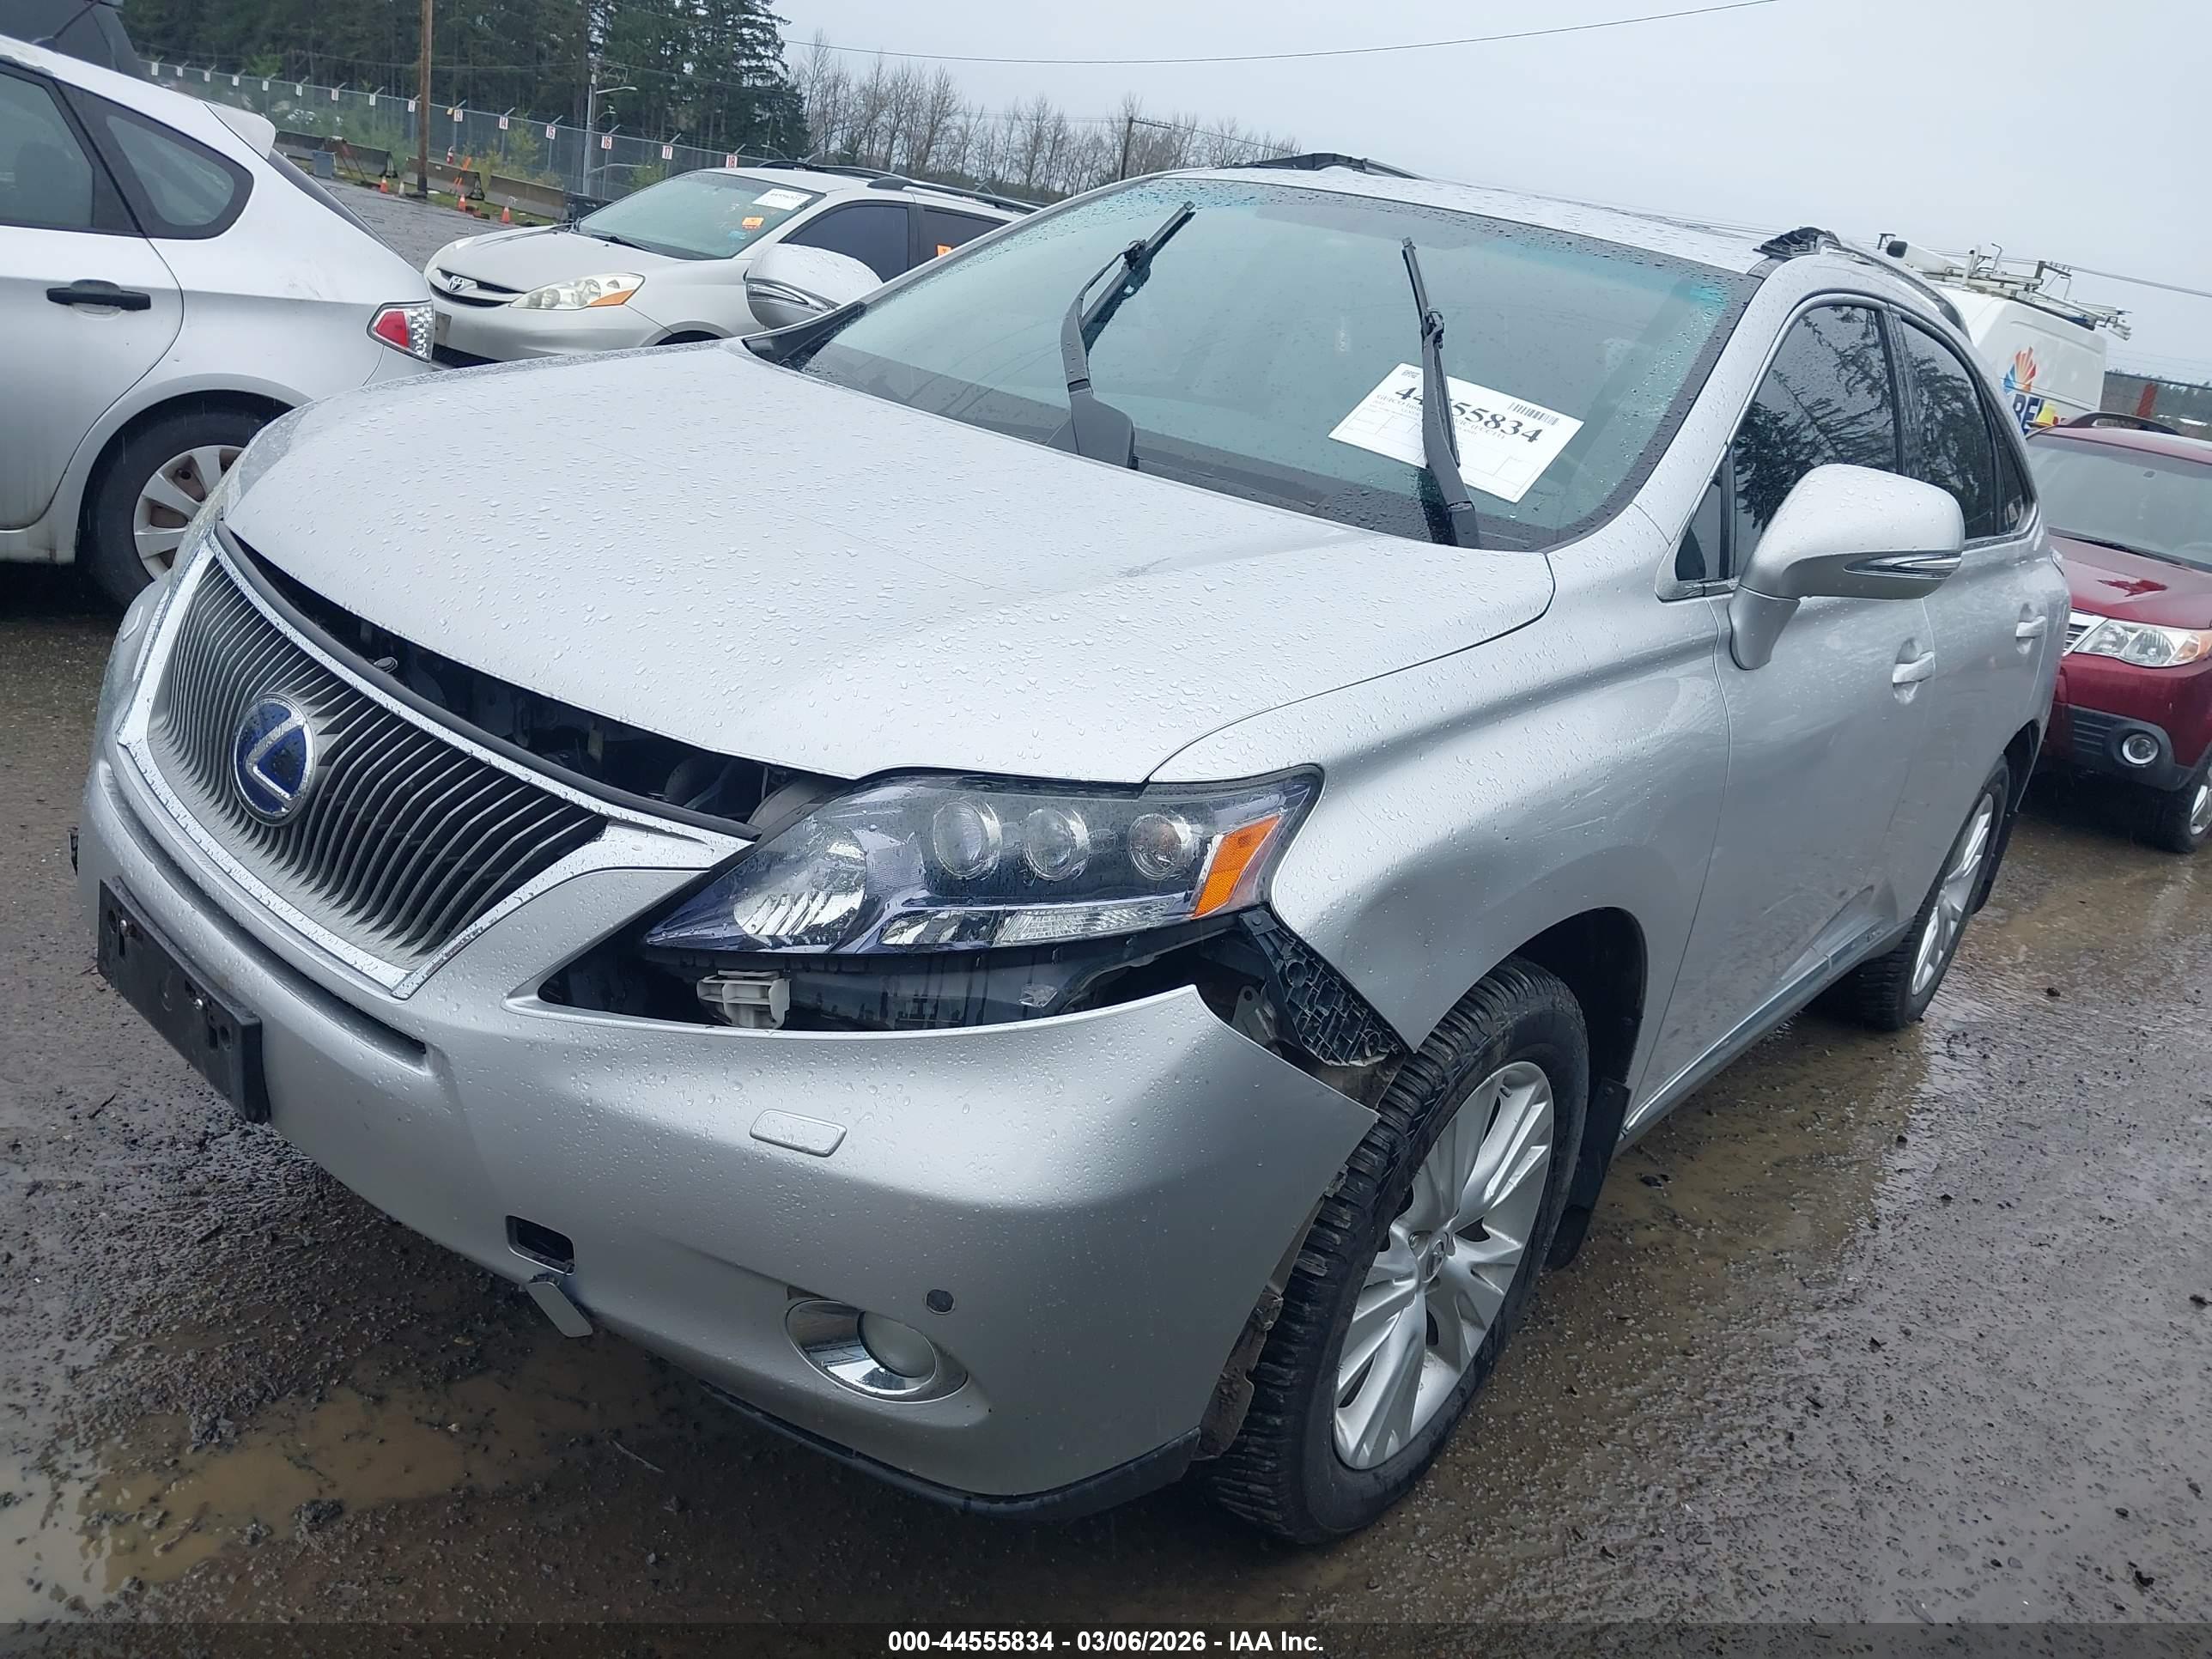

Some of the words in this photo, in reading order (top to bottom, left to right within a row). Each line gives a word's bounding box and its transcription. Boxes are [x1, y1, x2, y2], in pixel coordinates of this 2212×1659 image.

[500, 117, 507, 129] 14
[547, 126, 555, 138] 15
[603, 137, 611, 149] 16
[665, 147, 672, 159] 17
[727, 156, 736, 167] 18
[1395, 386, 1543, 443] 4455834
